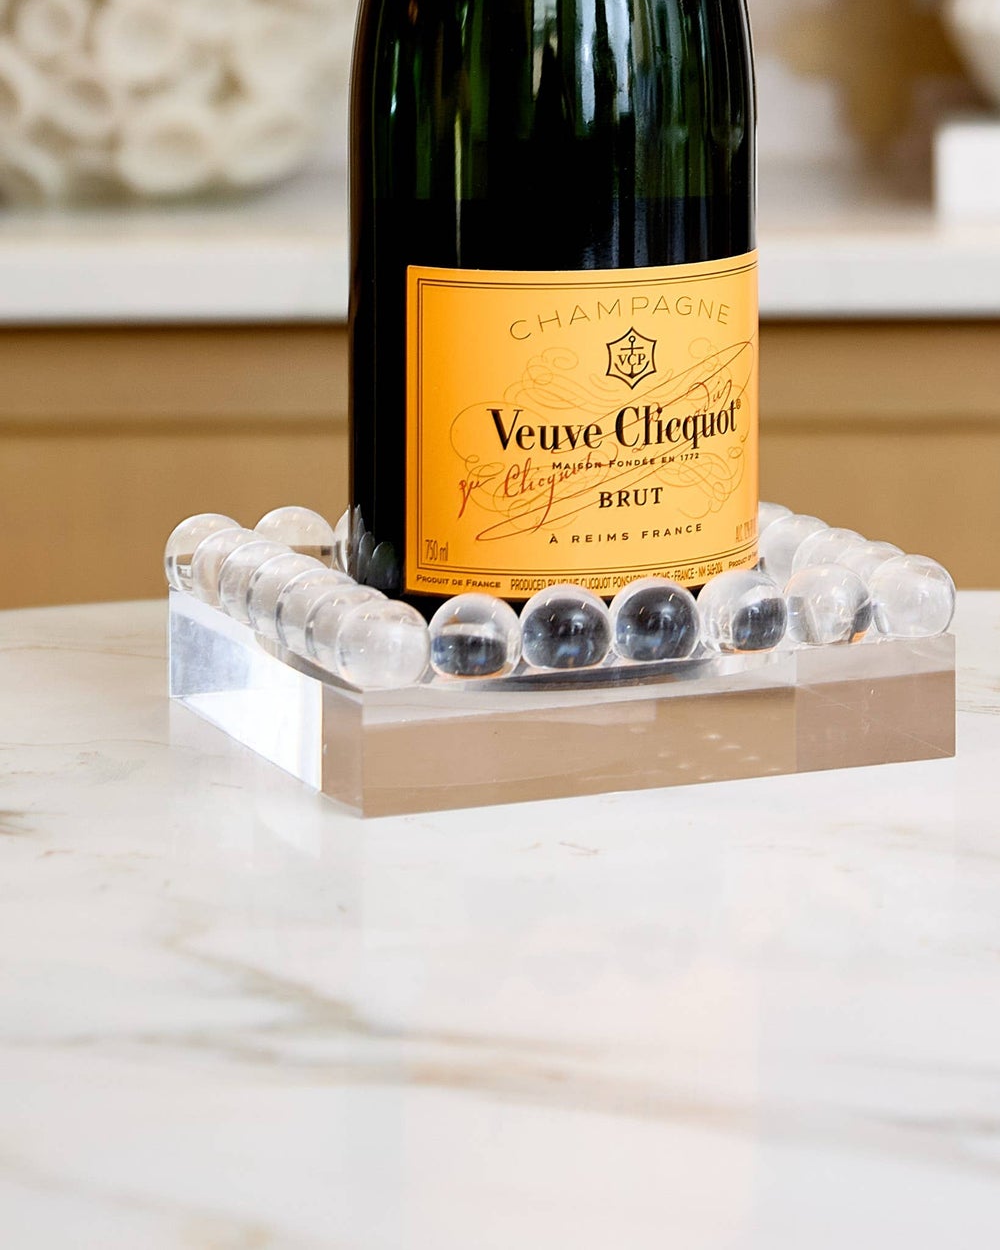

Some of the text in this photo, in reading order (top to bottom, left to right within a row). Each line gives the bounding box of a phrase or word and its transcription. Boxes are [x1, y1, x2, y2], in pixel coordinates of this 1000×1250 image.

[509, 295, 730, 340] CHAMPAGNE
[617, 353, 646, 366] VCP
[487, 408, 602, 451] Veuve
[552, 452, 700, 471] MAISON FONDÉE EN 1772
[598, 487, 664, 509] BRUT
[549, 523, 703, 544] À REIMS FRANCE
[425, 539, 449, 562] 750 ml
[466, 579, 501, 588] FRANCE
